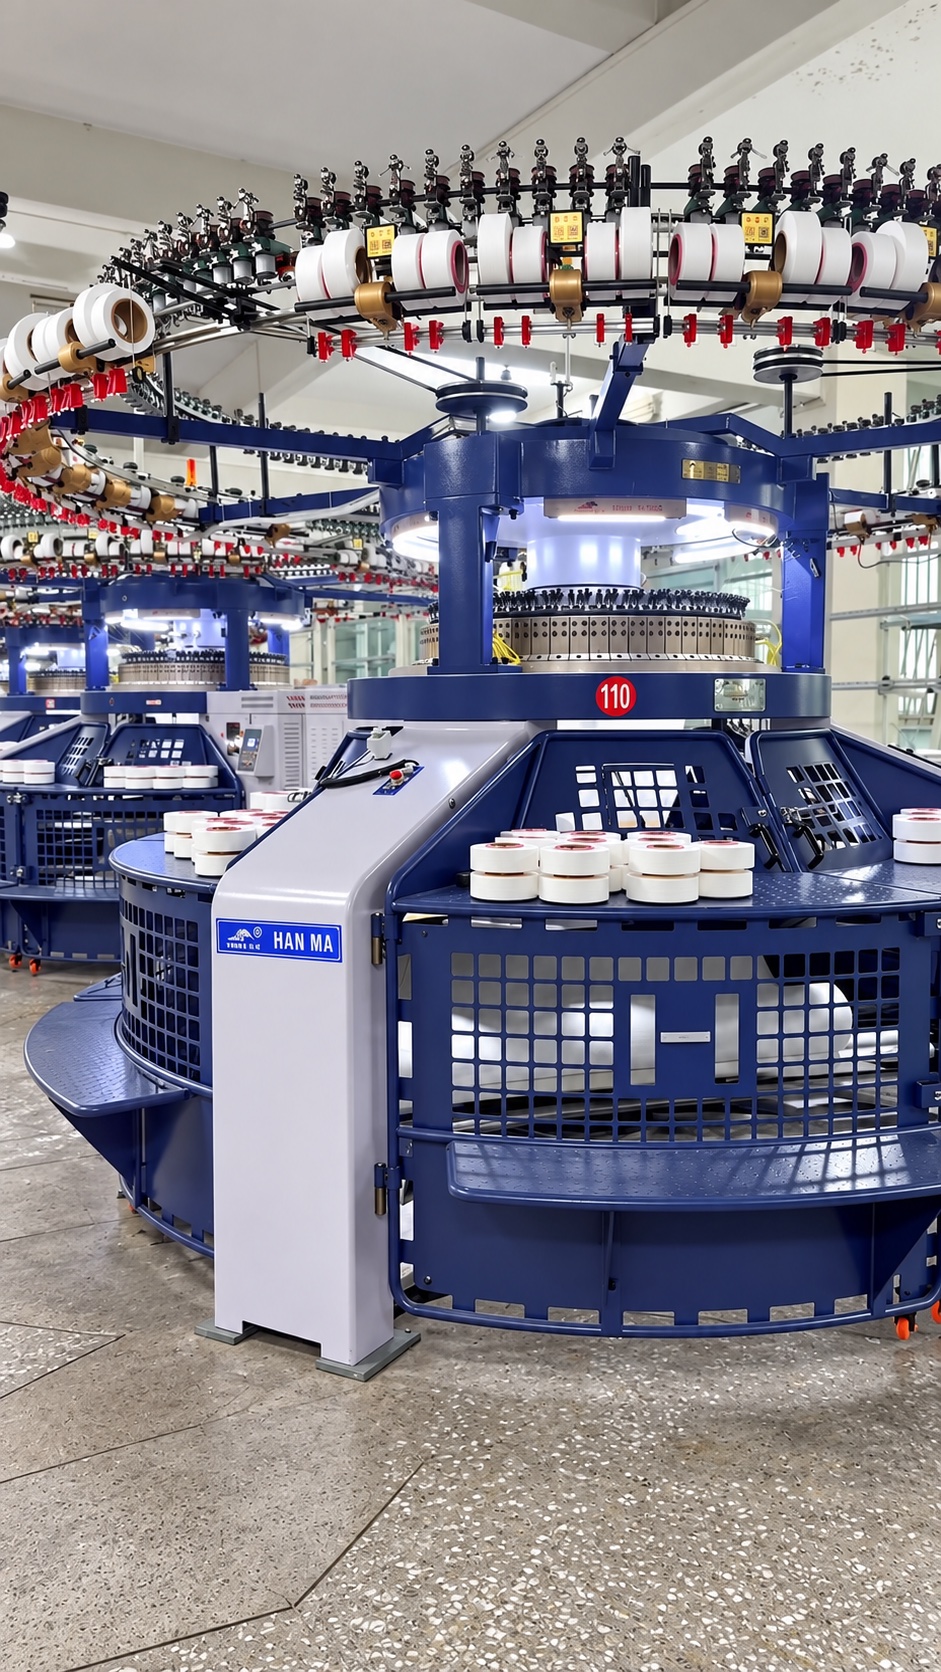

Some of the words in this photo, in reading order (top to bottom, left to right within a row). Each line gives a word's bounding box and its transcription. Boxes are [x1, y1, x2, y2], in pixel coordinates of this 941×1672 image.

[600, 683, 631, 709] 110
[273, 931, 305, 951] HAN
[310, 933, 333, 953] MA
